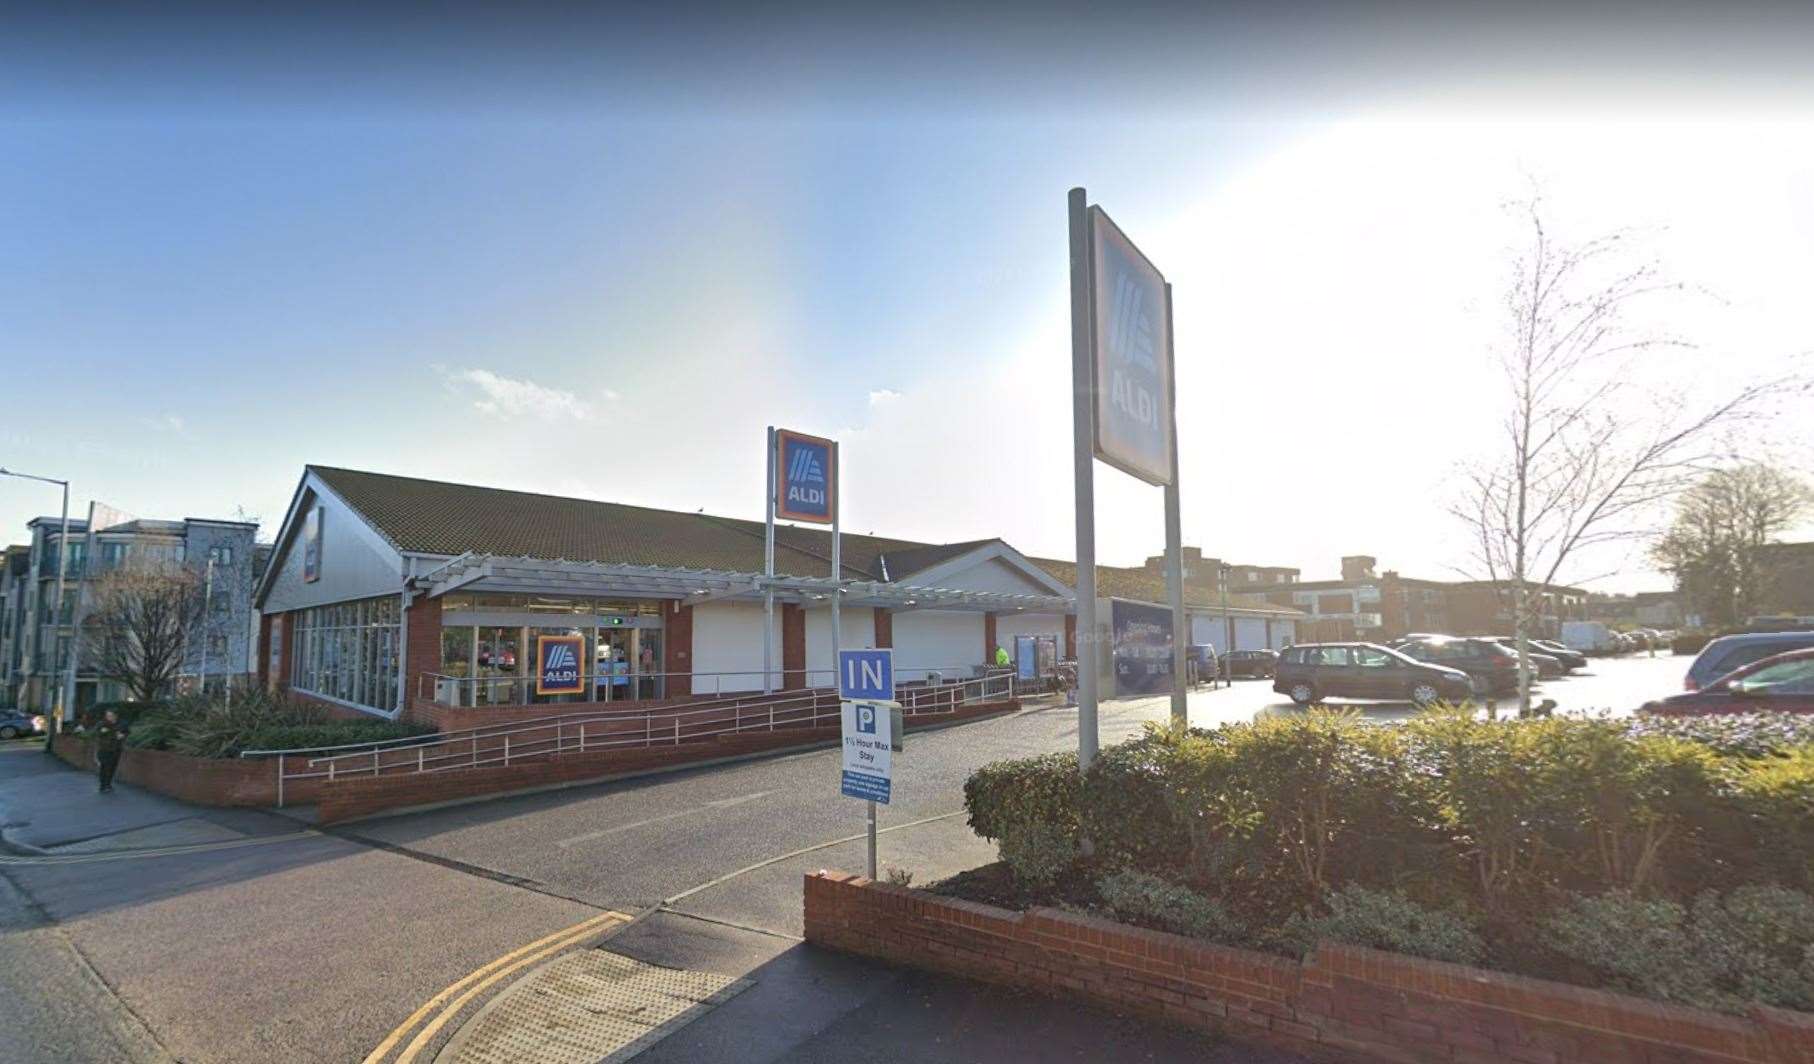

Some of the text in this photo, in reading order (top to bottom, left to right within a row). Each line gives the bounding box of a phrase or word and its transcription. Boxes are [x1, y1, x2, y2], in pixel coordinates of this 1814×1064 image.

[1111, 371, 1158, 431] ALDI
[788, 485, 825, 505] ALDI
[545, 671, 577, 682] ALDI
[848, 659, 883, 690] IN
[858, 707, 874, 731] P
[856, 738, 873, 748] Hour
[875, 741, 889, 751] Max
[859, 751, 875, 763] Stay
